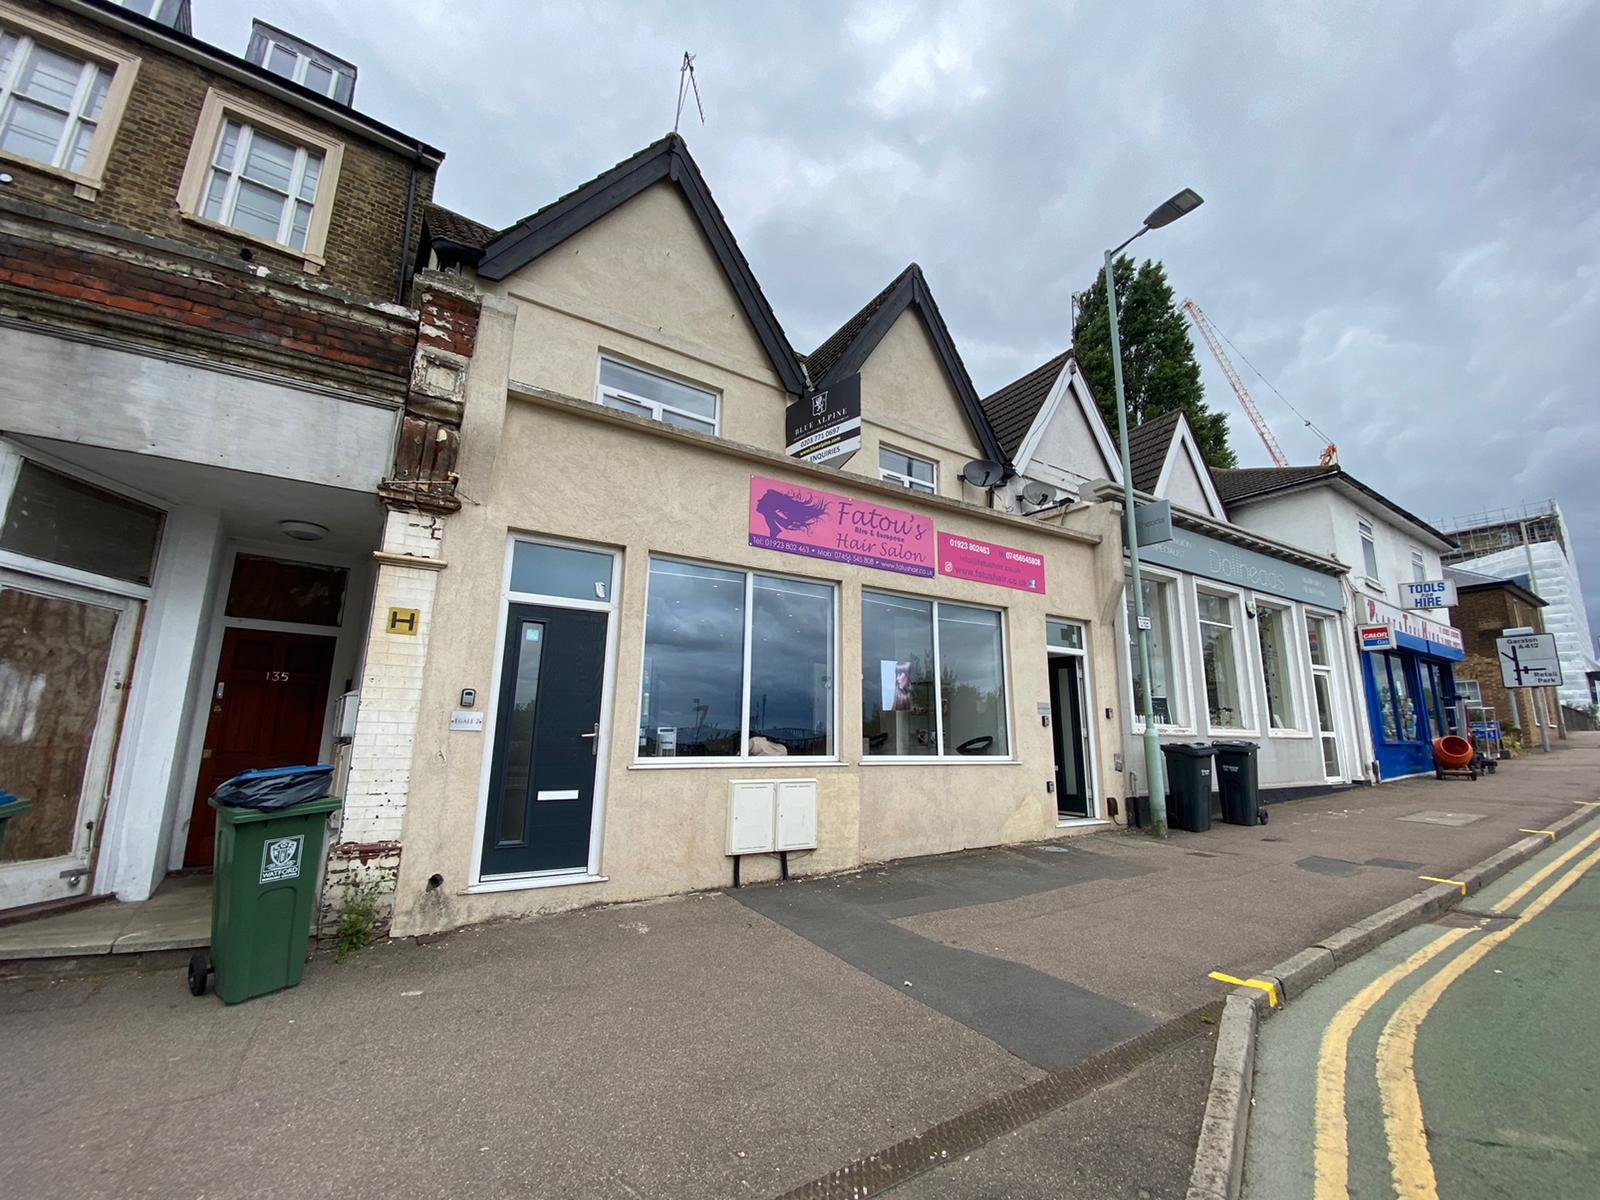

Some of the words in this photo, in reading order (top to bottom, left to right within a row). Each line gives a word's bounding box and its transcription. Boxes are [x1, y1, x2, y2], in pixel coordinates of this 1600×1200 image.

[795, 421, 814, 436] BLUE
[818, 407, 848, 425] ALPINE
[814, 432, 825, 442] 771
[825, 426, 840, 437] 0697
[838, 501, 928, 541] Fatou's
[764, 538, 785, 549] 01923
[785, 542, 798, 551] 802
[798, 545, 810, 554] 463
[836, 533, 876, 553] Hair
[879, 542, 926, 563] Salon
[949, 538, 968, 550] 01923
[969, 543, 990, 555] 802463
[1208, 548, 1287, 592] Dollheads
[1408, 582, 1445, 594] TOOLS
[1414, 596, 1442, 608] HIRE
[391, 611, 415, 631] H
[265, 671, 289, 682] 135
[262, 866, 298, 878] WATFORD
